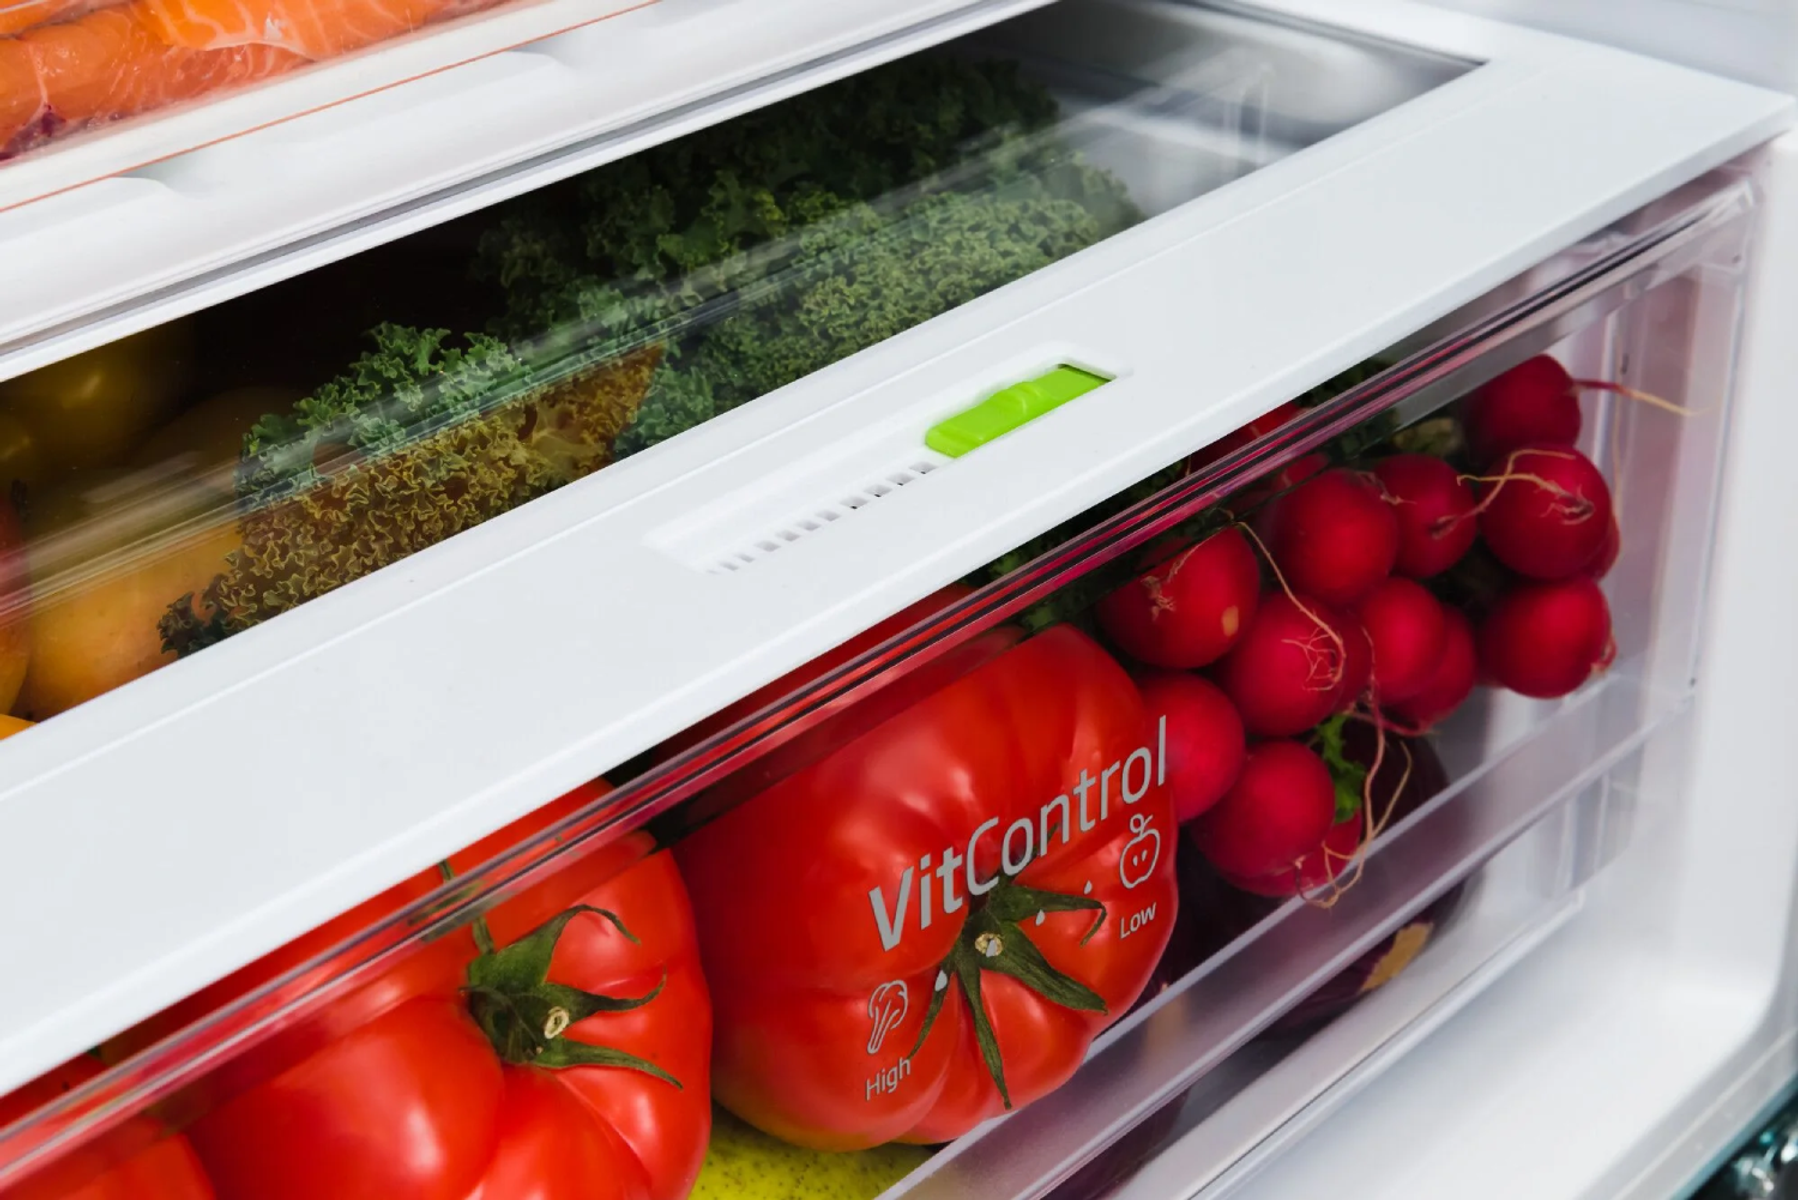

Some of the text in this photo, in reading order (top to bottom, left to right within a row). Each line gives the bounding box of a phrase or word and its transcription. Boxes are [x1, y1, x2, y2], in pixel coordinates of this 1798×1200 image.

[868, 715, 1167, 952] VitControl
[1120, 902, 1157, 939] Low
[865, 1056, 912, 1101] High
